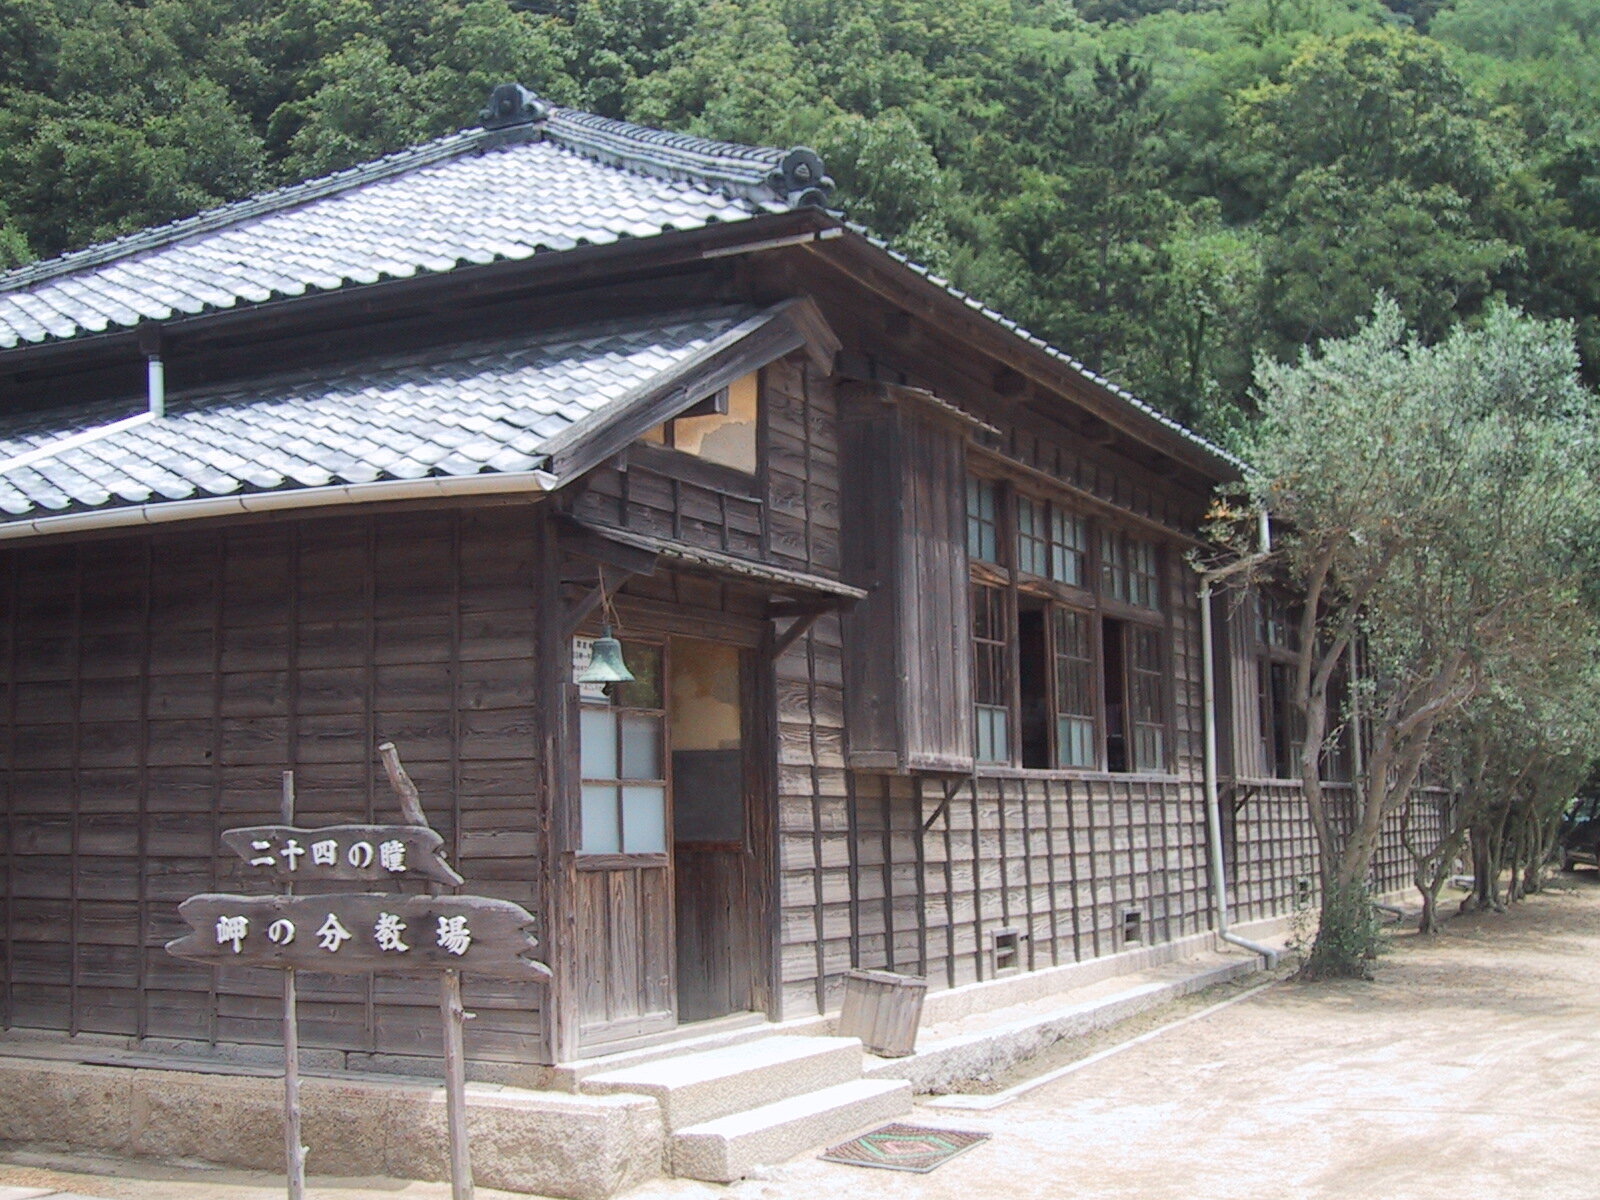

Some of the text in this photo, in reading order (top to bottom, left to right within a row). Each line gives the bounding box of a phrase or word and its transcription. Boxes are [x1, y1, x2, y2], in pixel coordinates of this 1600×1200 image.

[250, 840, 407, 872] 二十四の瞳
[216, 913, 472, 956] 岬の分教場
